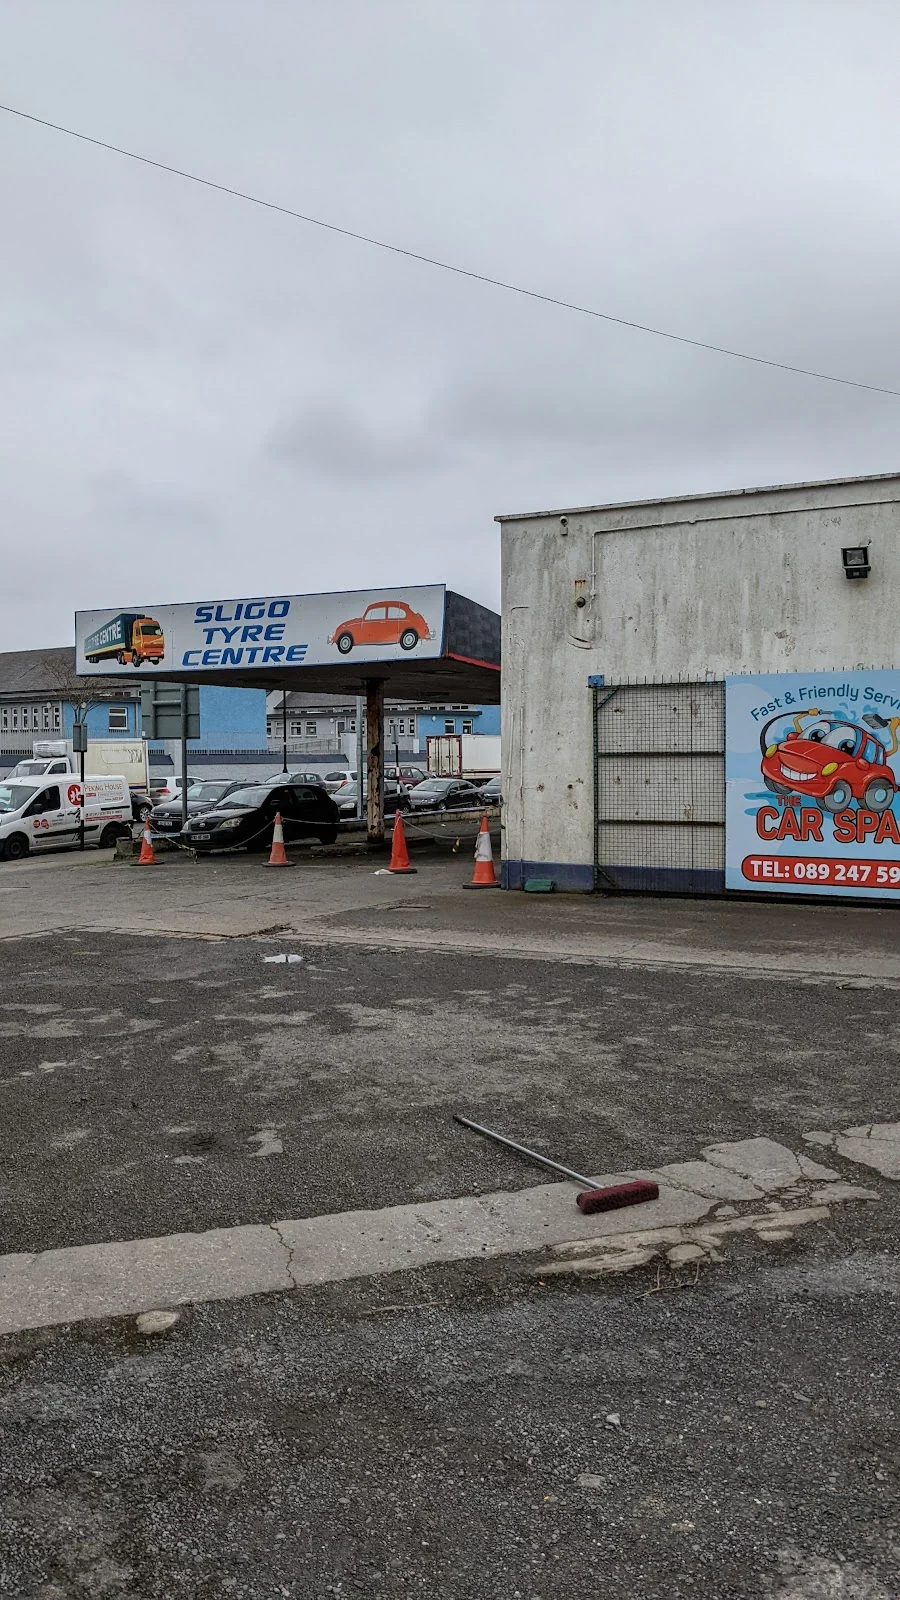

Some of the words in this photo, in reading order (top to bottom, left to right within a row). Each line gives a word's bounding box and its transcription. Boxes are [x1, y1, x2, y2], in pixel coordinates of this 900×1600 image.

[194, 600, 291, 623] SLIGO
[202, 623, 286, 645] TYRE
[181, 644, 309, 667] CENTRE
[750, 697, 783, 721] Fast
[784, 691, 796, 705] &
[798, 683, 859, 702] Friendly
[104, 782, 123, 791] HOUSE
[776, 795, 802, 807] THE
[756, 805, 824, 842] CAR
[832, 808, 900, 844] SPA
[750, 860, 790, 878] TEL:
[793, 863, 830, 880] 089
[834, 864, 872, 882] 247
[876, 866, 900, 883] 59
